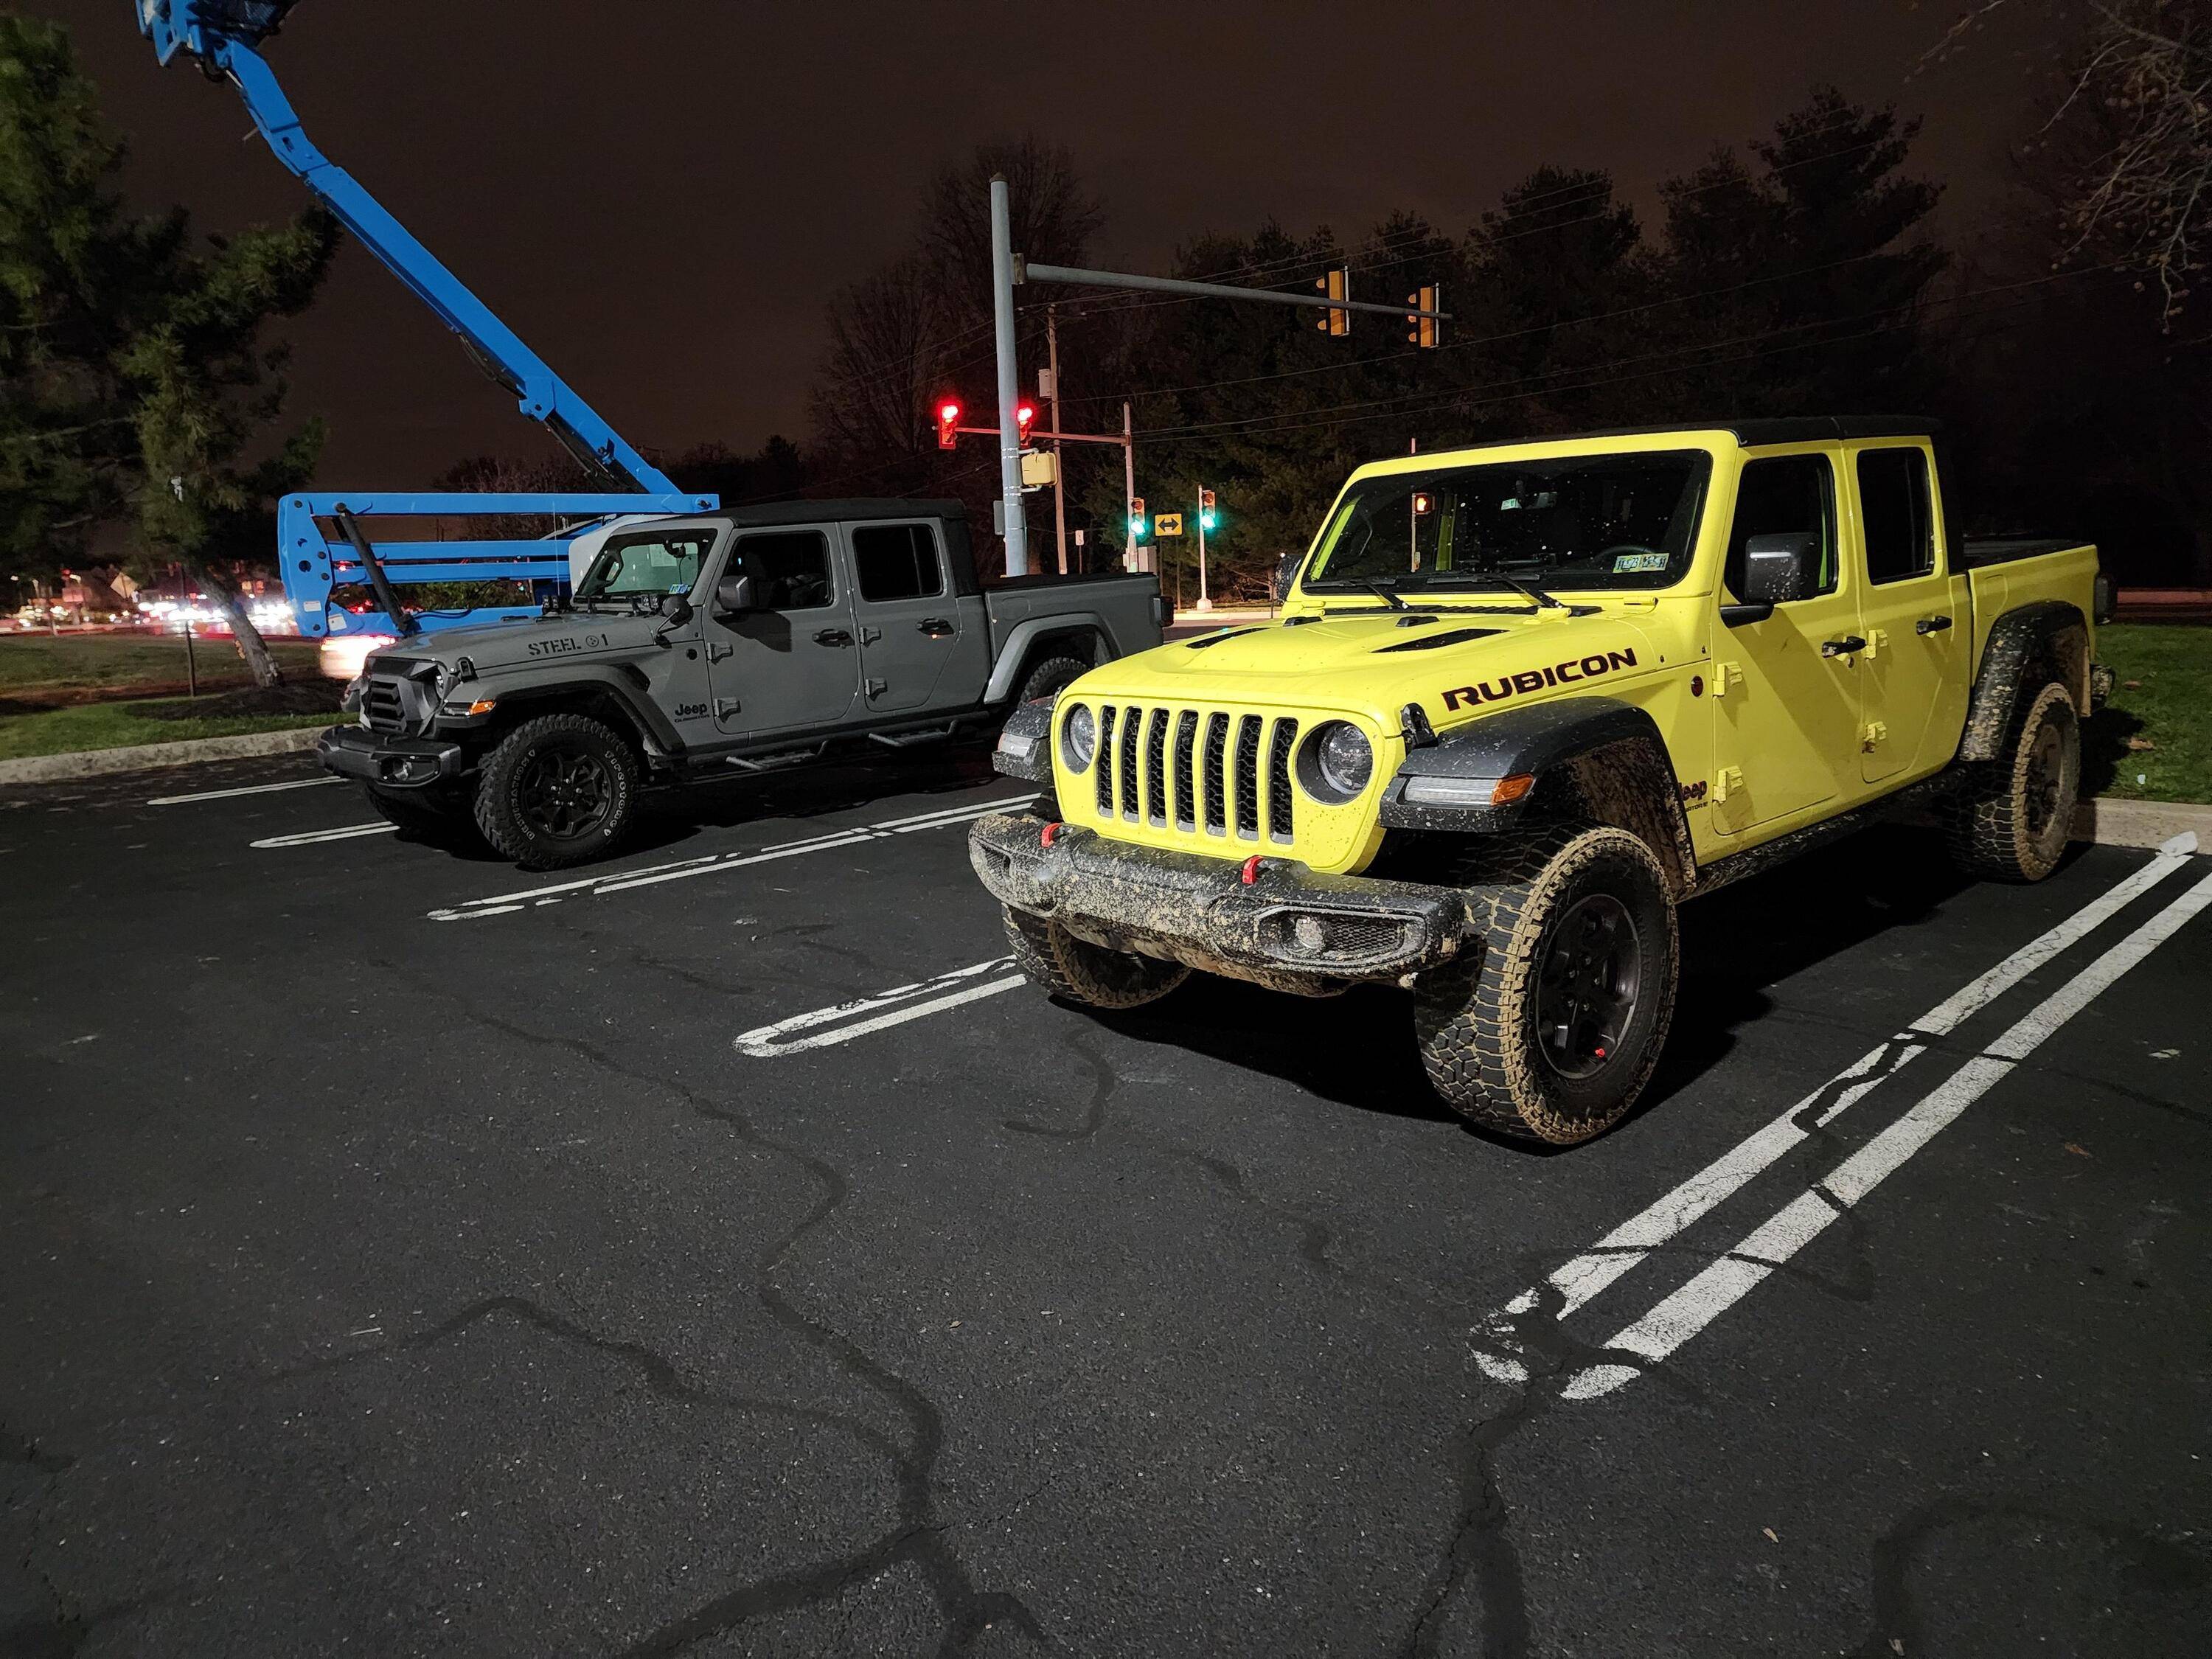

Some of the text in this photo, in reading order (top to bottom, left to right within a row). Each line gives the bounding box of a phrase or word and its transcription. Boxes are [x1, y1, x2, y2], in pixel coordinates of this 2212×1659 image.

[528, 633, 609, 655] STEEL 1
[1441, 647, 1638, 712] RUBICON
[674, 703, 708, 716] Jeep
[1678, 780, 1708, 801] eep
